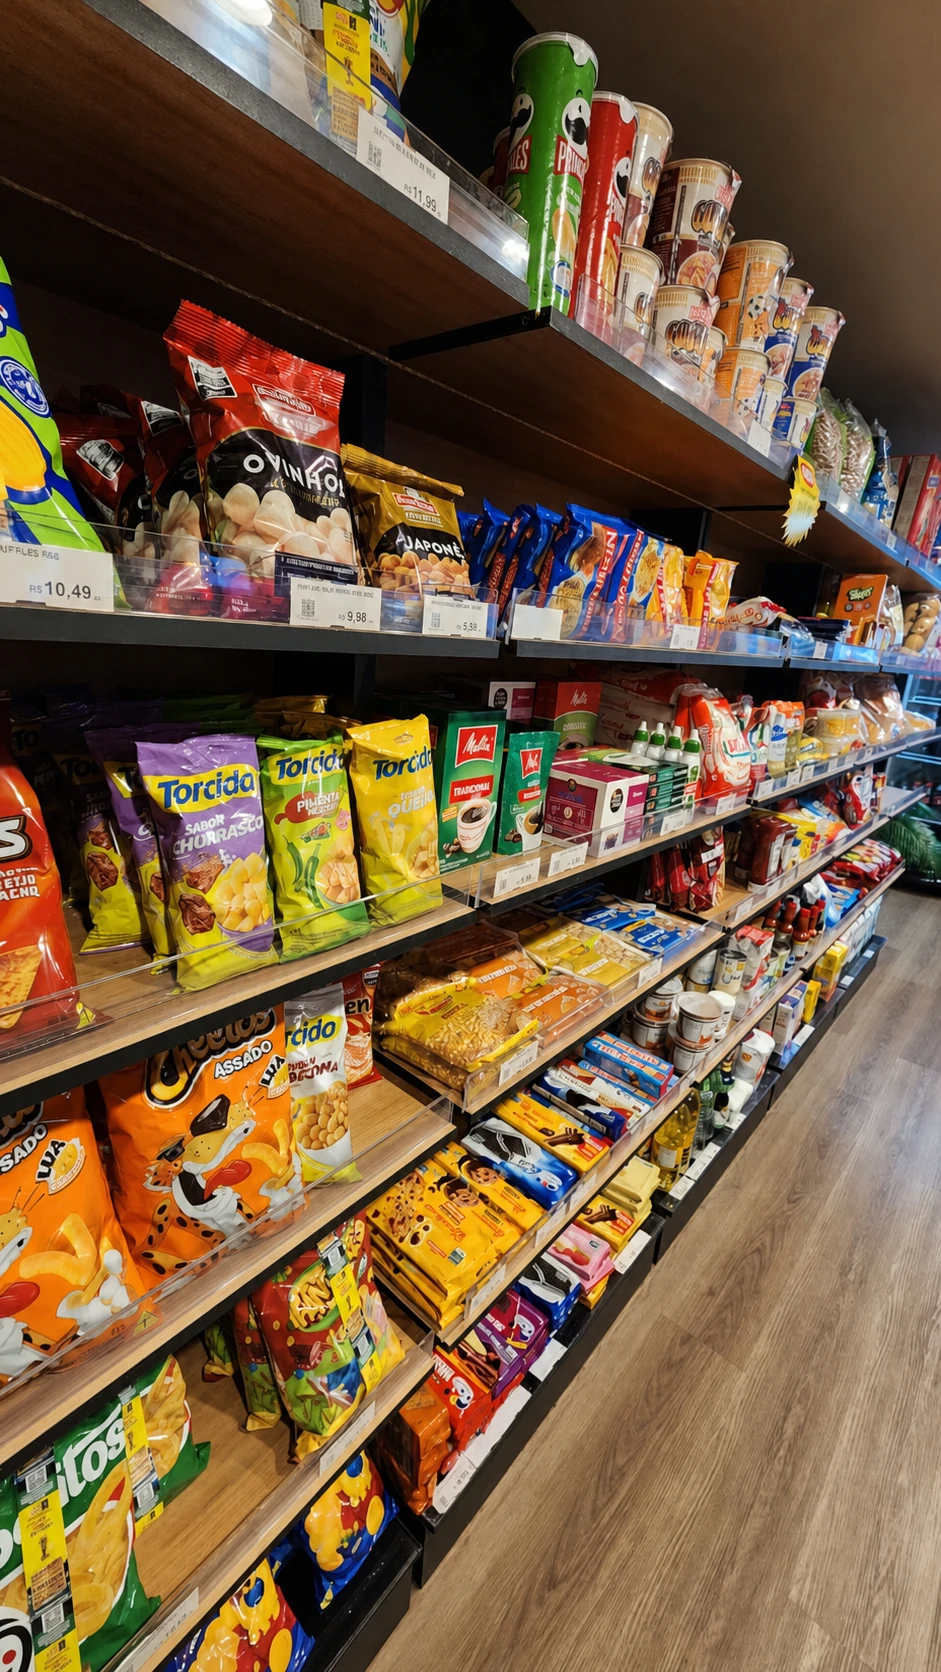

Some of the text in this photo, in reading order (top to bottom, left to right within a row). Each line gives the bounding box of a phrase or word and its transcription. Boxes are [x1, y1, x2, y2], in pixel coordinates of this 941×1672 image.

[45, 580, 92, 600] 10,49
[347, 610, 367, 624] 9,98
[158, 769, 255, 809] Torcida
[172, 815, 265, 856] CHURRASCO
[185, 813, 226, 836] SABOR
[214, 1039, 274, 1080] ASSADO
